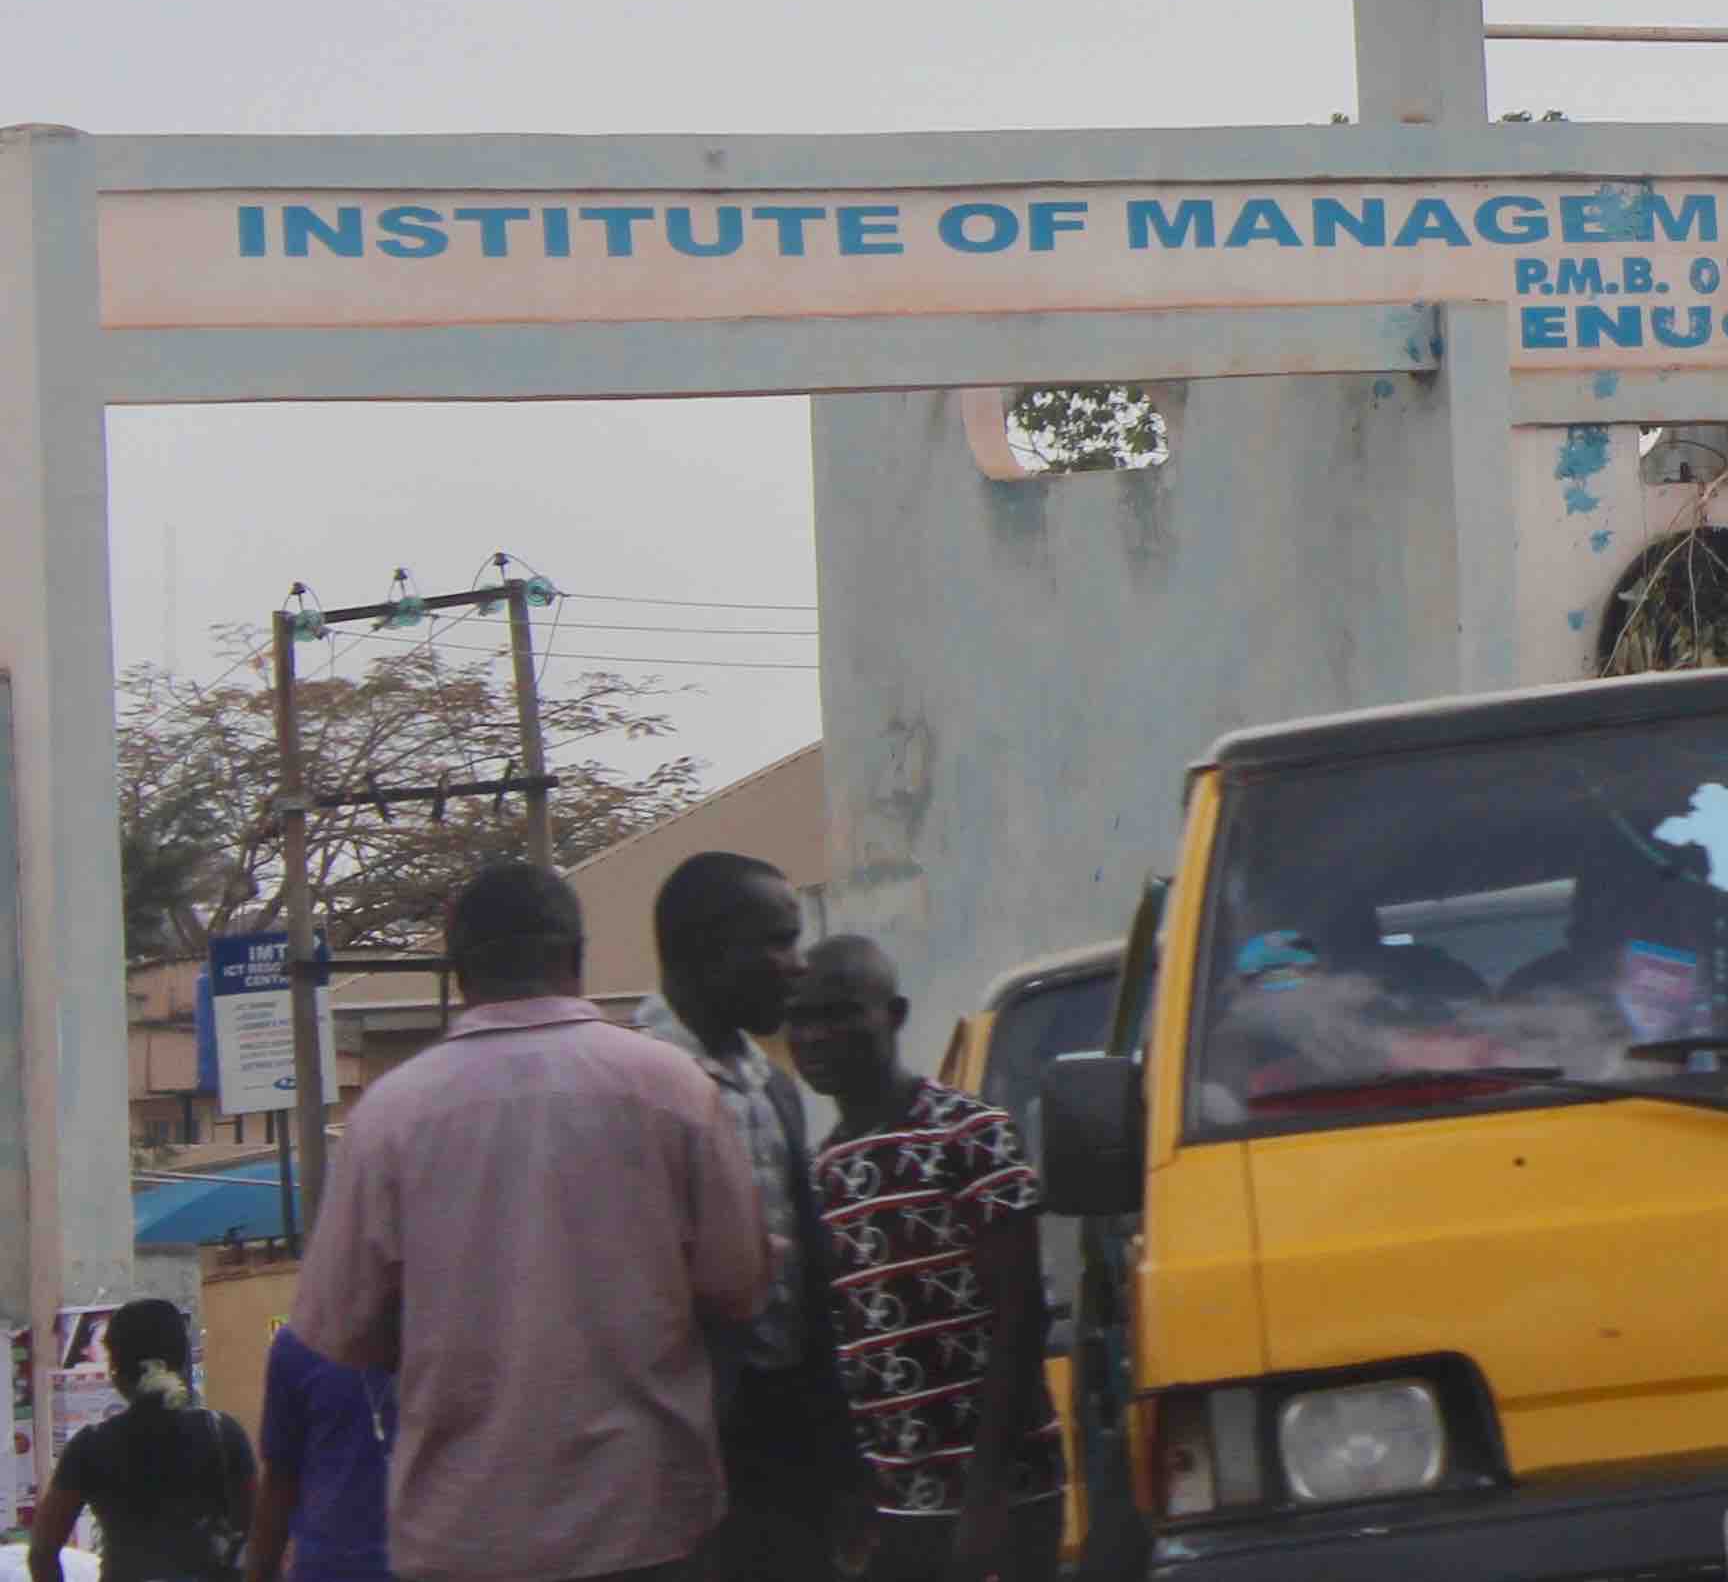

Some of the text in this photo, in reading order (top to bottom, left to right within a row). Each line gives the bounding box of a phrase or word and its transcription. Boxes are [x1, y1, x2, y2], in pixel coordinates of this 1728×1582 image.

[237, 205, 903, 259] INSTITUTE
[936, 201, 1091, 254] OF
[1514, 256, 1671, 295] P.M.B.
[248, 943, 288, 961] IMT
